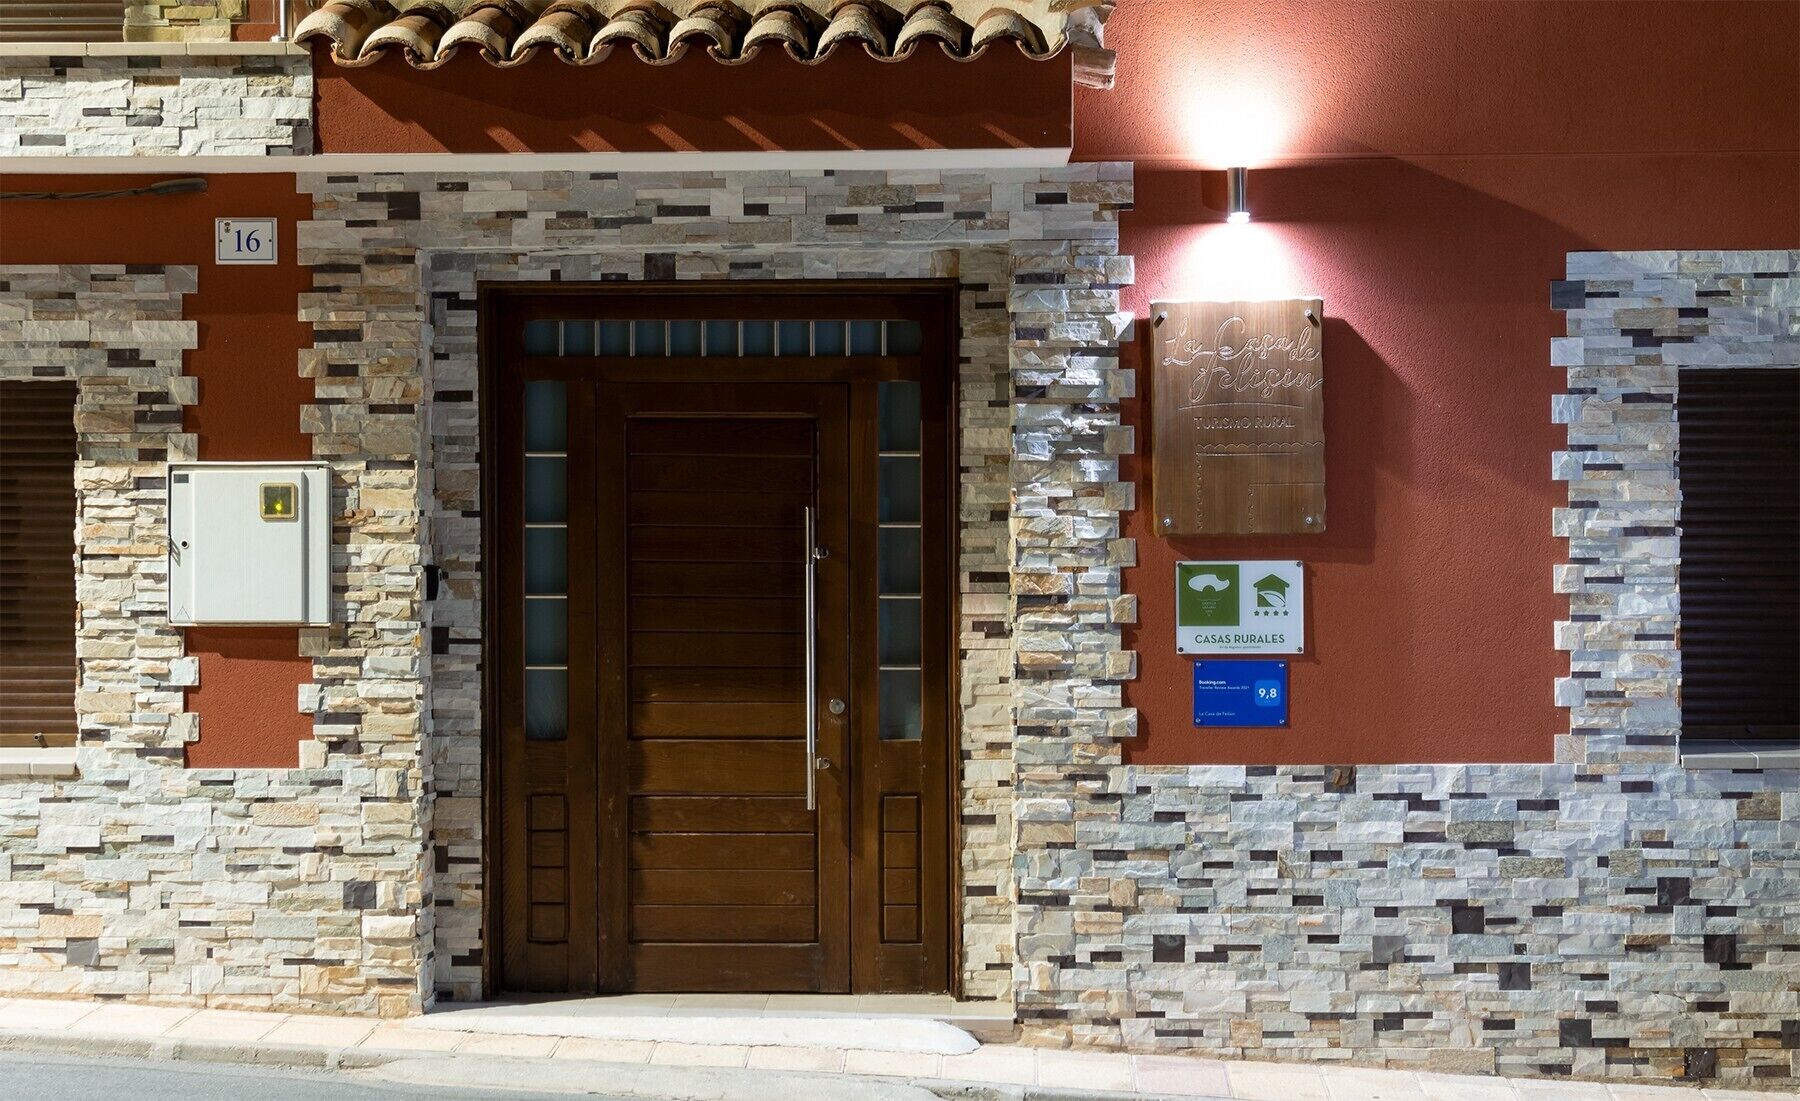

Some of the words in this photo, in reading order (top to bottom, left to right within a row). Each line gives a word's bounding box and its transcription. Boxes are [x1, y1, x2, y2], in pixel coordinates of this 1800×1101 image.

[235, 229, 260, 252] 16
[1162, 317, 1203, 366] La
[1213, 316, 1294, 361] Casa
[1288, 325, 1320, 361] de
[1194, 417, 1251, 429] TURISMO
[1255, 417, 1295, 428] RURAL
[1195, 634, 1231, 644] CASAS
[1234, 634, 1285, 644] RURALES
[1258, 688, 1277, 699] 9,8
